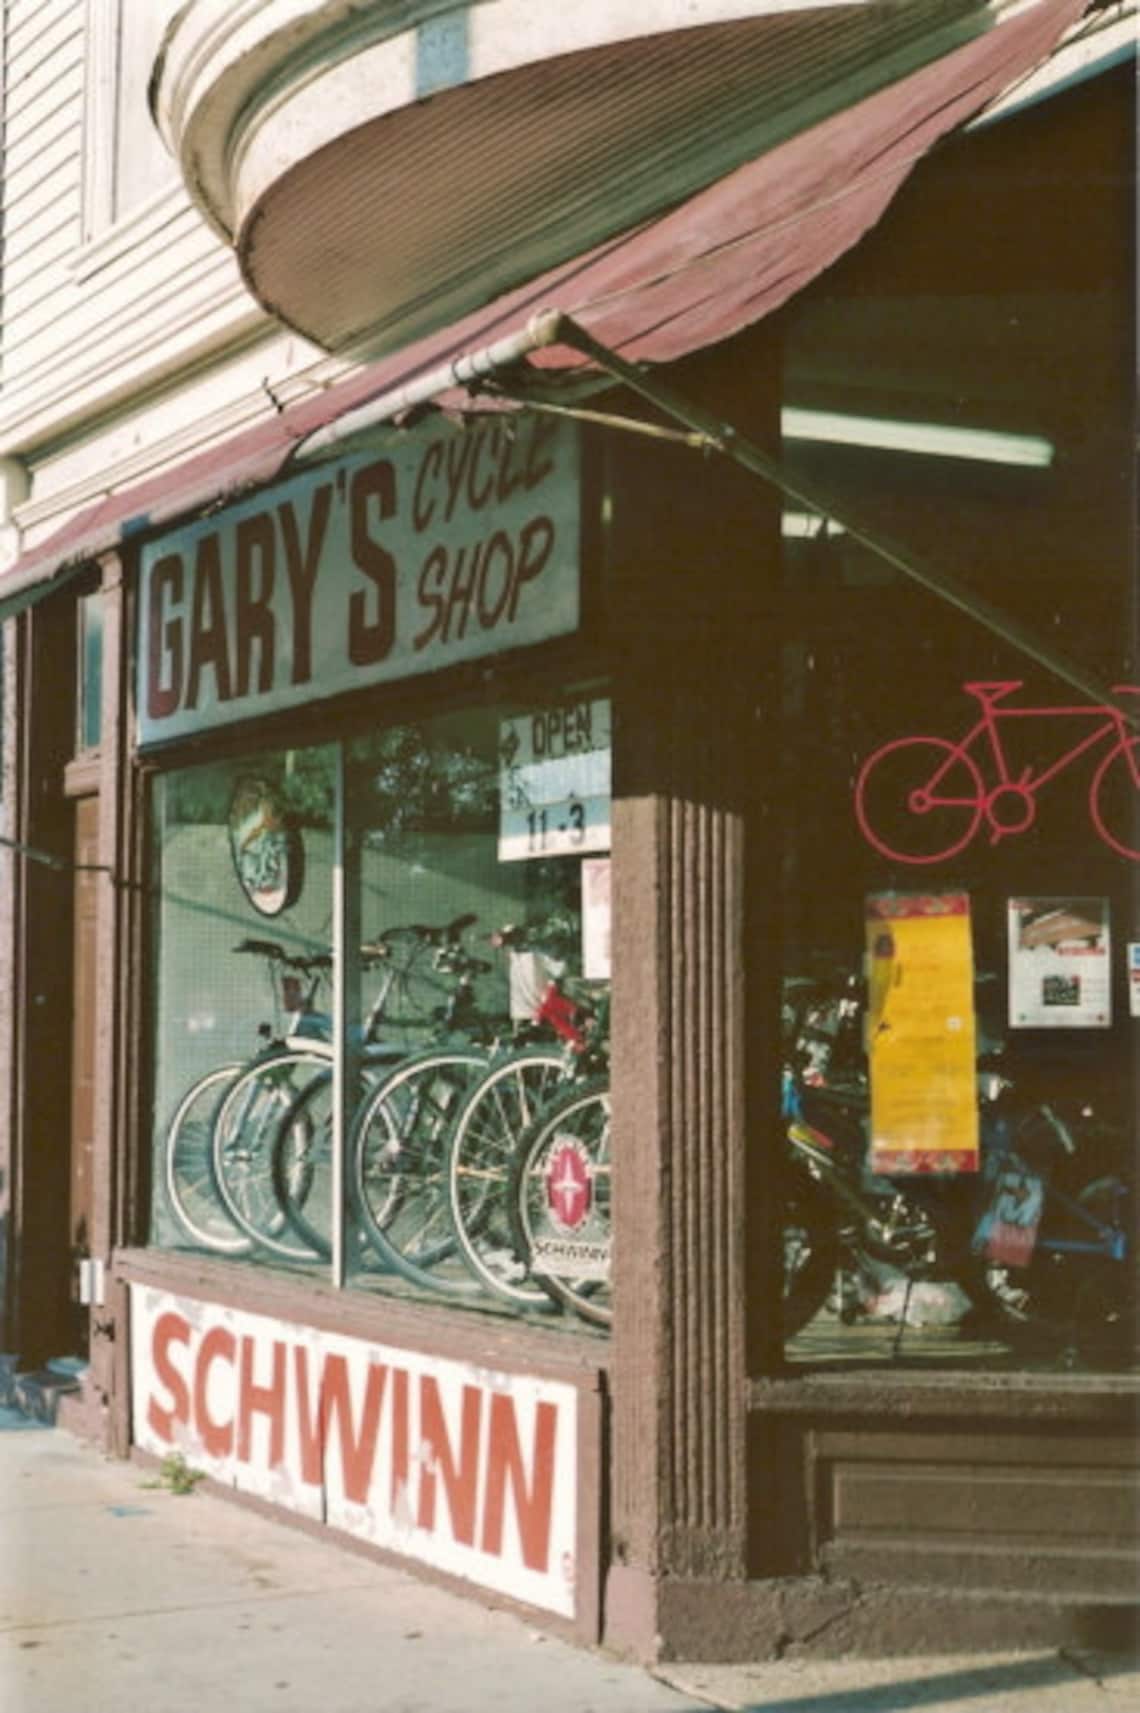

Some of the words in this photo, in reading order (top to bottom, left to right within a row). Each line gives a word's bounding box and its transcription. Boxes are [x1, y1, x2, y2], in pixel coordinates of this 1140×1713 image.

[148, 459, 396, 720] GARY'S
[412, 415, 557, 534] CYCLE
[413, 515, 555, 651] SHOP
[532, 703, 592, 756] OPEN
[147, 1311, 558, 1574] SCHWINN
